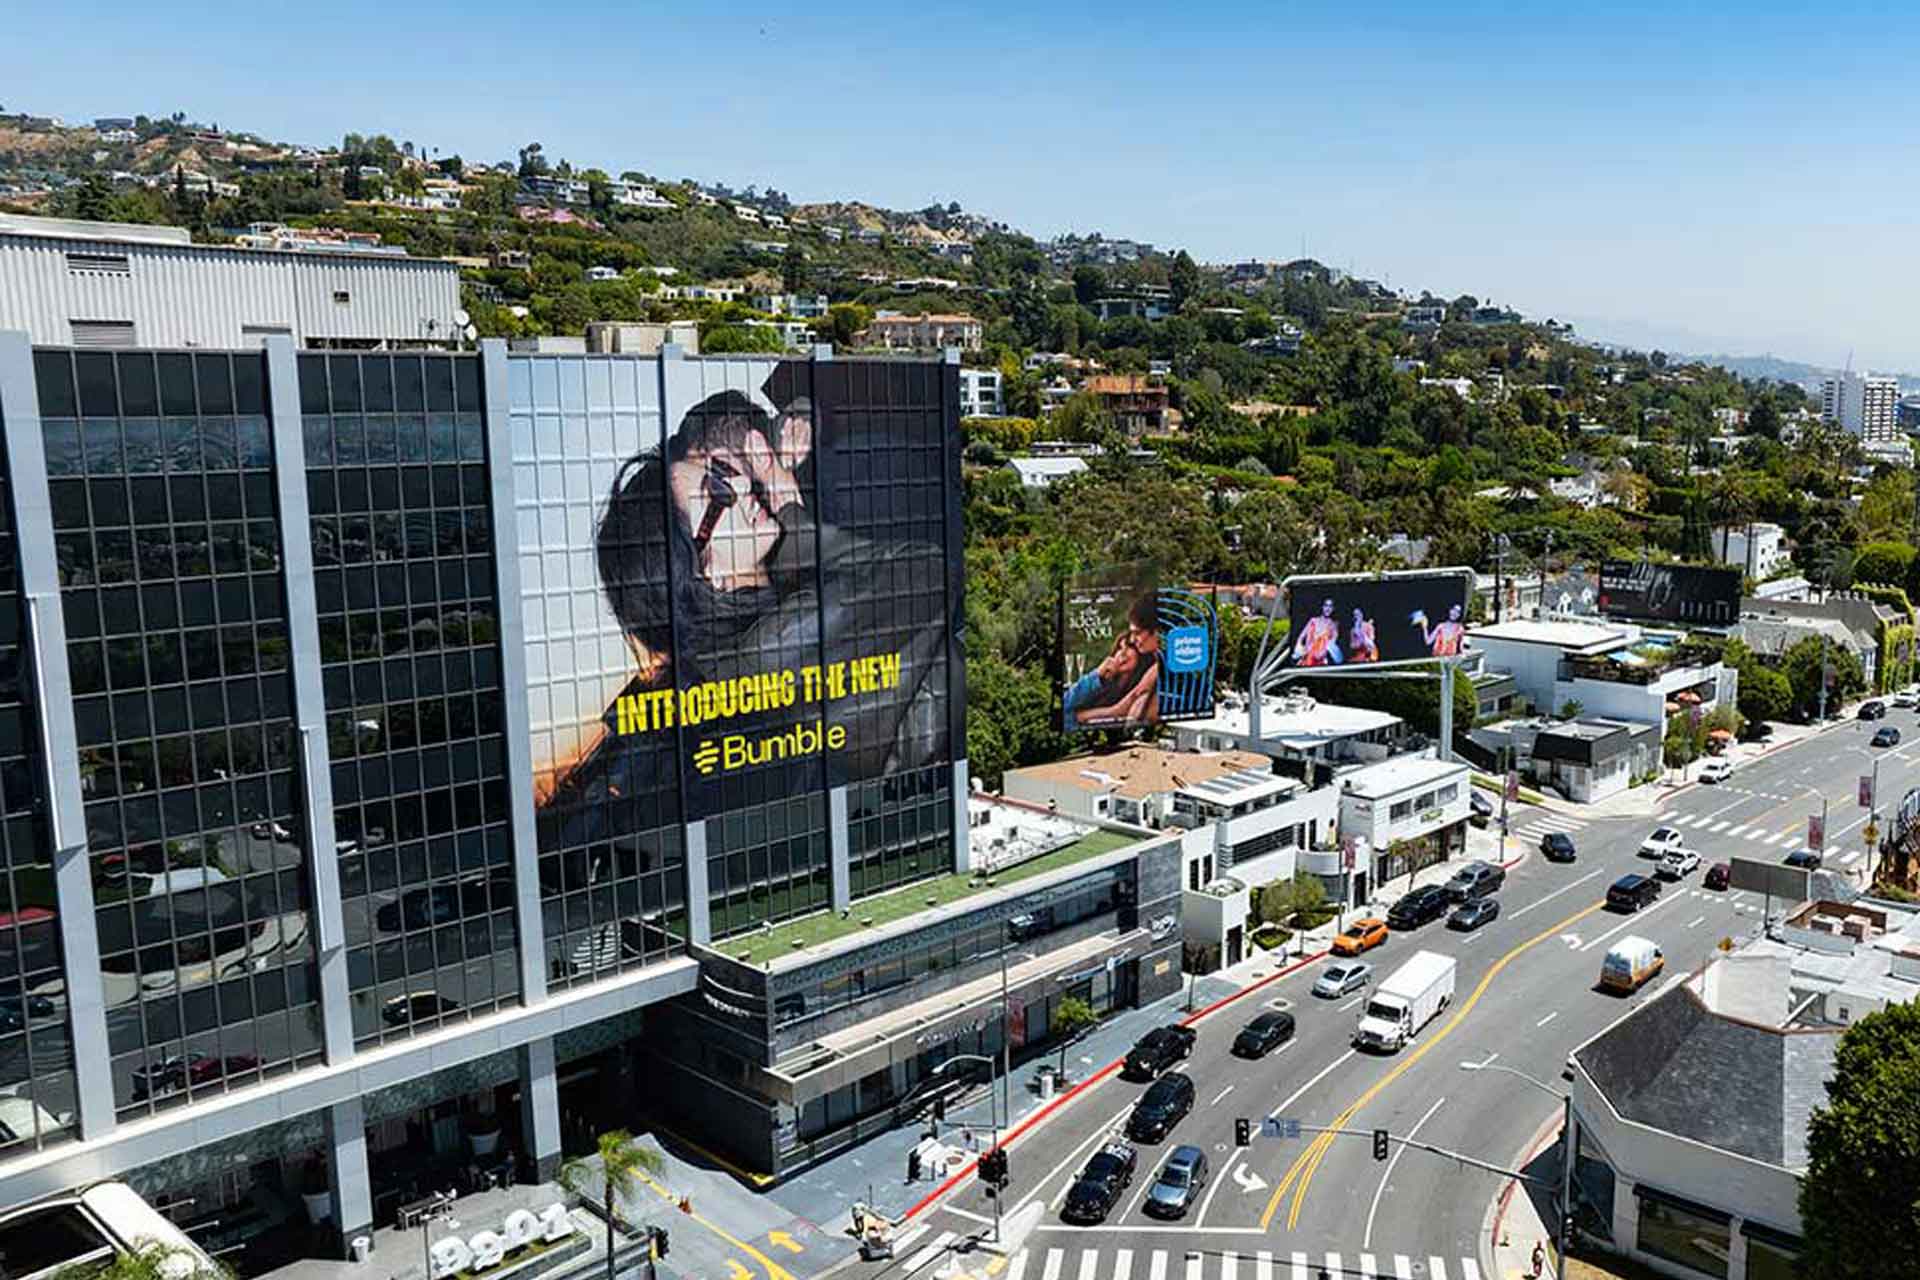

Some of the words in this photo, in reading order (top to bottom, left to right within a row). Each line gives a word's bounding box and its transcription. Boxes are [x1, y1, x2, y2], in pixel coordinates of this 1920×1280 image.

[616, 669, 796, 736] INTRODUCING
[800, 661, 848, 704] THE
[850, 652, 901, 695] NEW
[723, 719, 847, 770] Bumble
